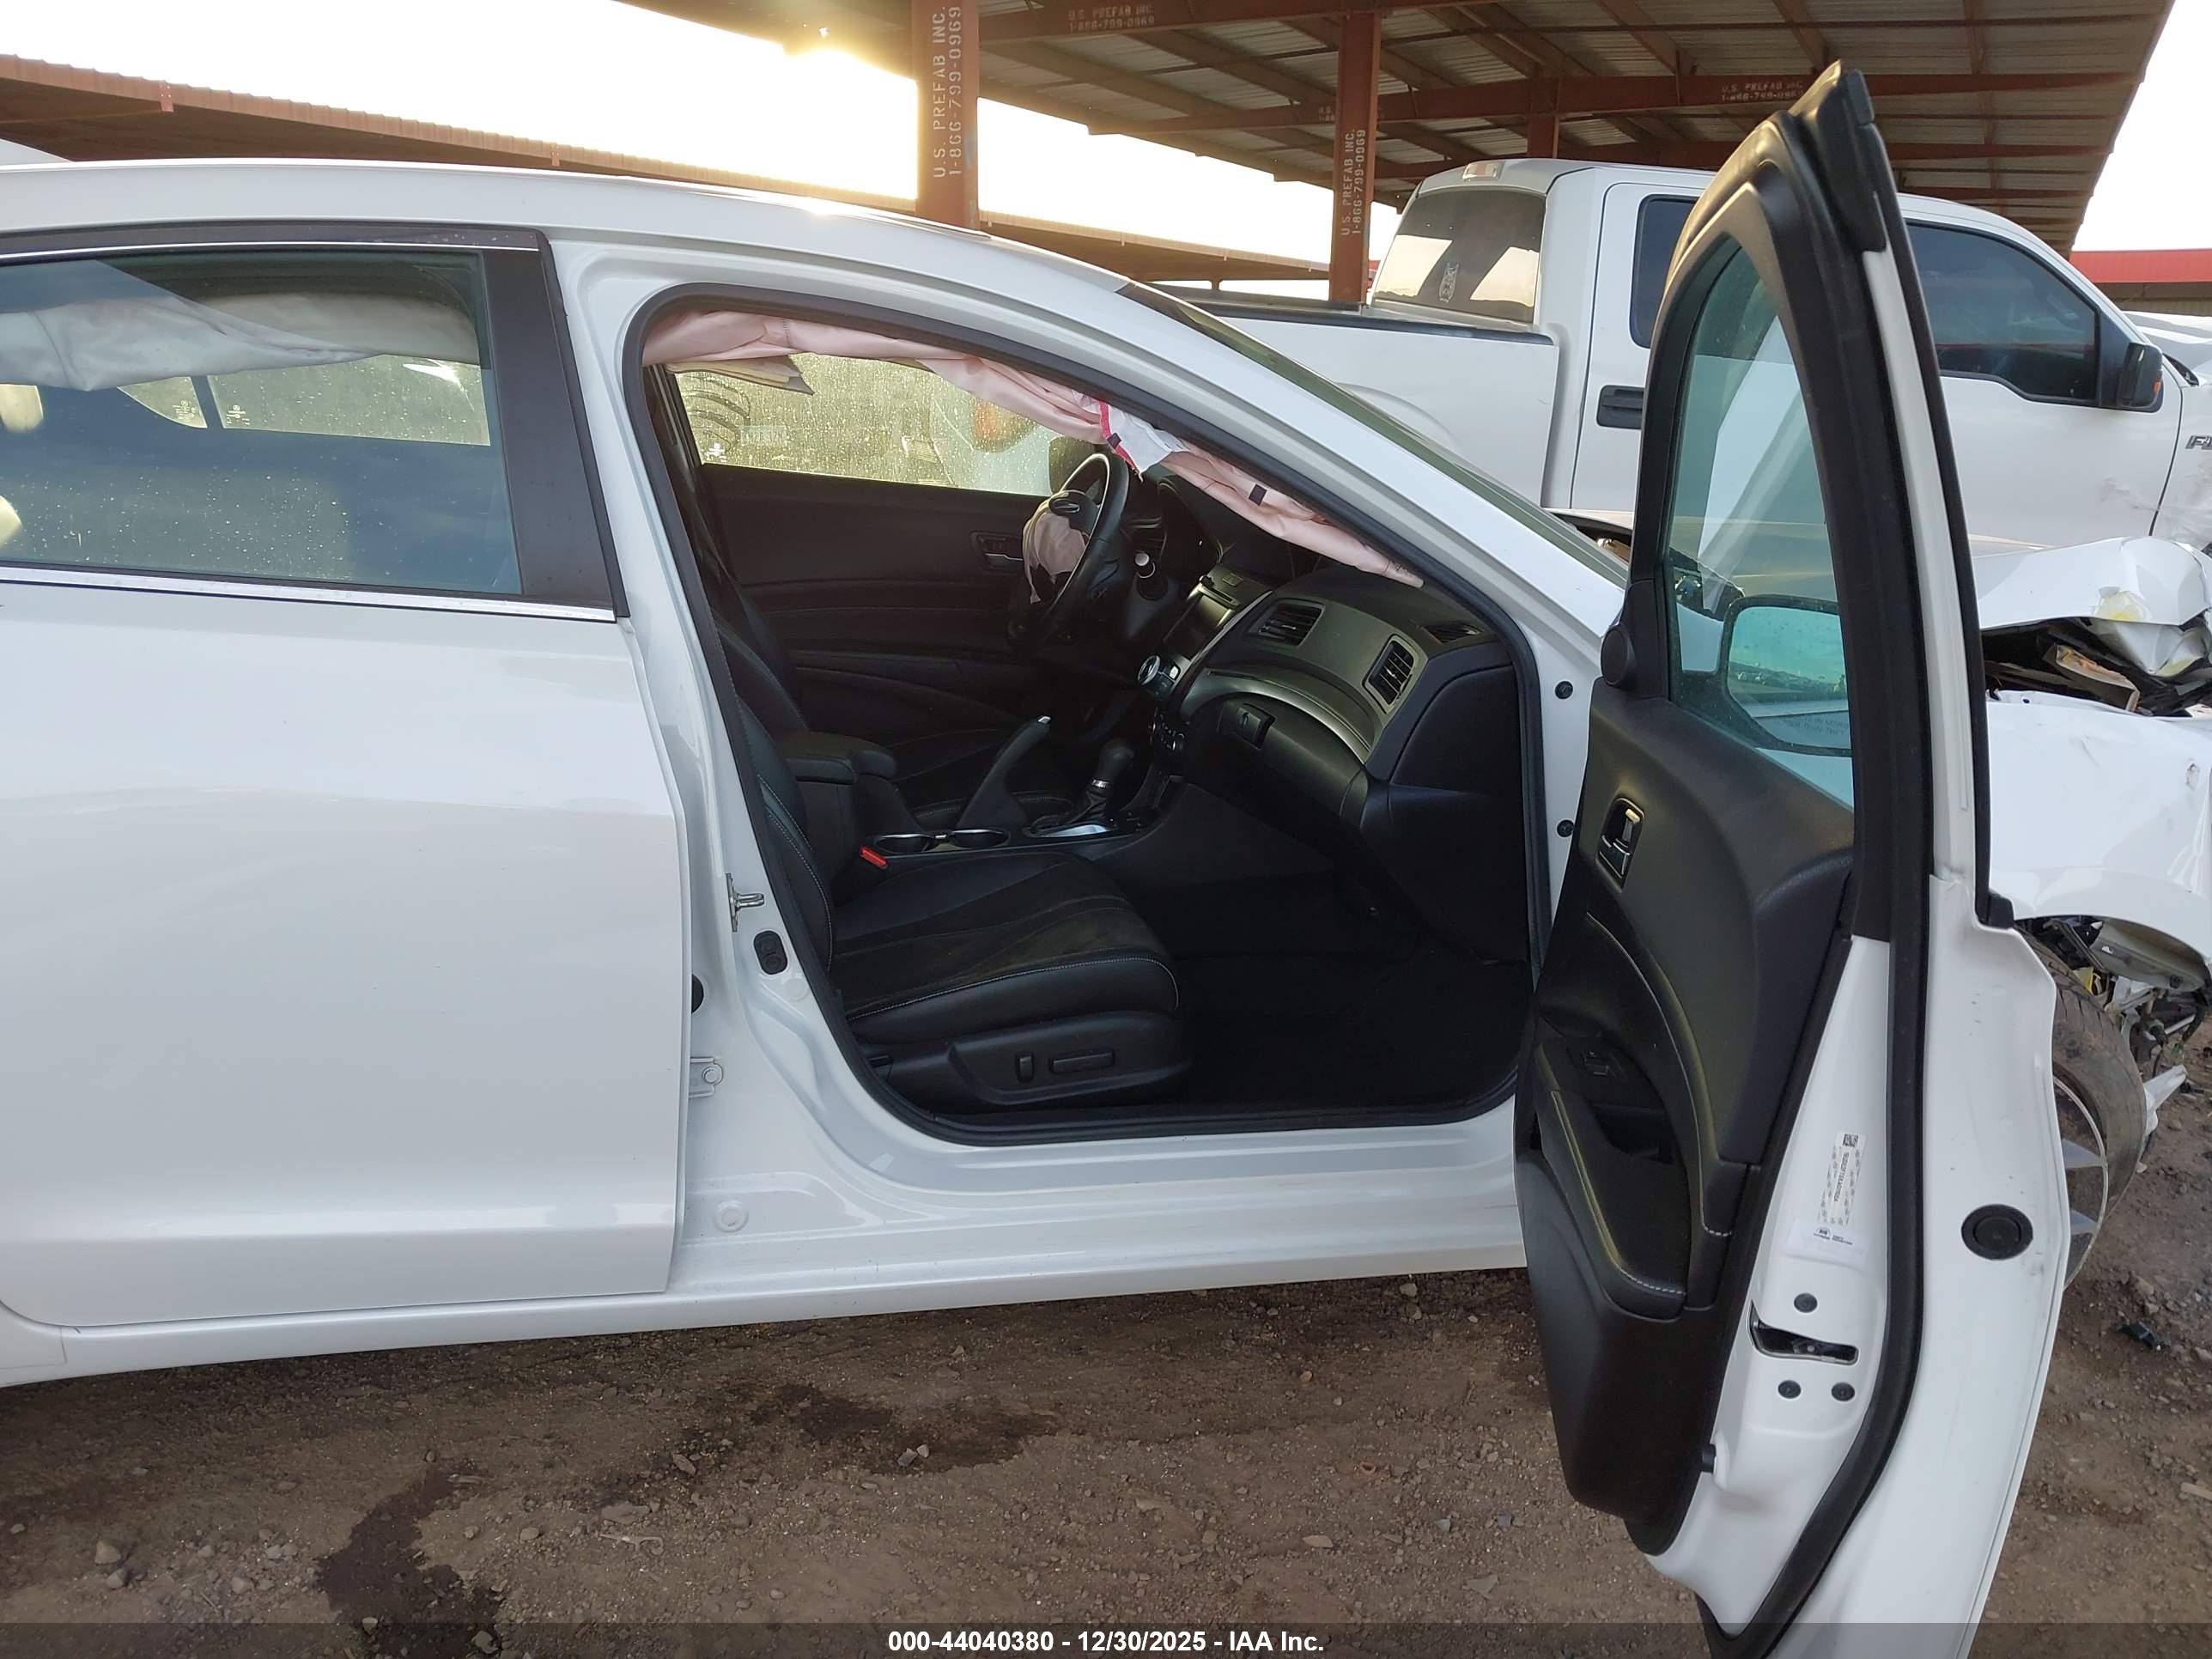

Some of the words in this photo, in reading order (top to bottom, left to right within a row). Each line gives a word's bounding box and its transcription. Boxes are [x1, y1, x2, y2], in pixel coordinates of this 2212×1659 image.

[932, 6, 945, 44] INC.
[933, 54, 946, 131] PREFAB
[948, 6, 962, 175] 1-866-799-0969
[933, 142, 946, 178] U.S.
[1345, 130, 1355, 153] INC.
[1342, 158, 1354, 207] PREFAB
[1352, 129, 1366, 234] 1-866-799-0969
[1341, 210, 1352, 236] U.S.
